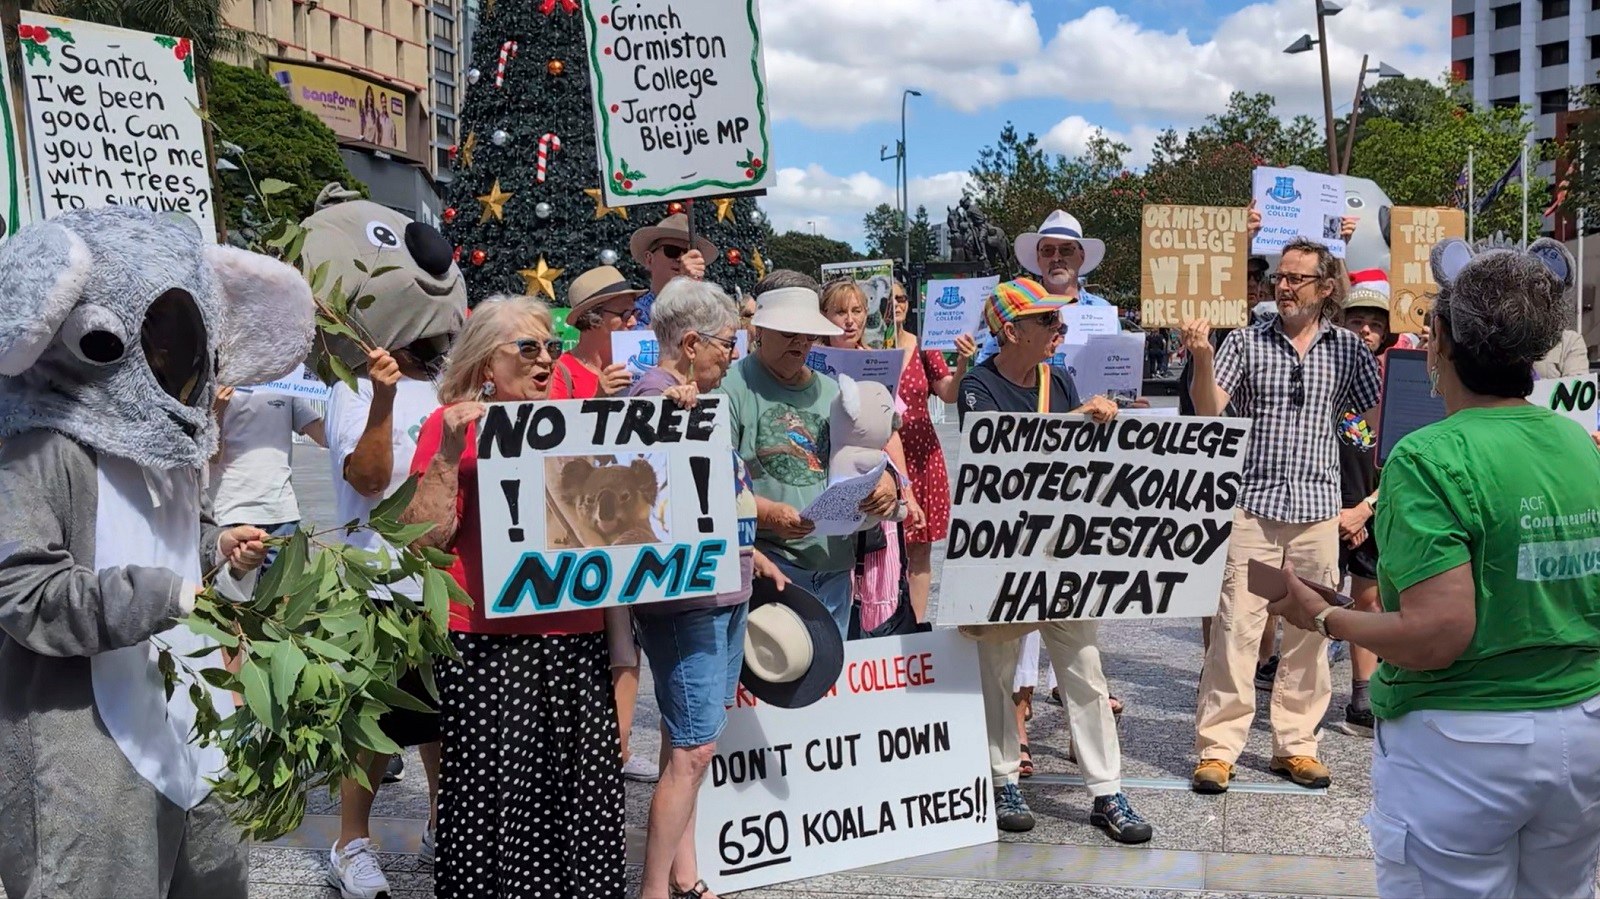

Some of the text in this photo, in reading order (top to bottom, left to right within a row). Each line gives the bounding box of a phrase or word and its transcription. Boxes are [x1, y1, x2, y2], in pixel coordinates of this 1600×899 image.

[611, 3, 681, 31] Grinch
[613, 31, 726, 61] Ormiston
[59, 44, 158, 85] Santa,
[32, 75, 164, 111] I've been
[634, 65, 717, 98] College
[42, 107, 179, 140] good. Can
[621, 98, 697, 124] Jarrod
[640, 117, 749, 155] Bleijie MP
[44, 137, 203, 174] you help me
[48, 162, 196, 195] with trees
[51, 188, 84, 210] to
[1265, 204, 1301, 213] ORMISTON
[1267, 210, 1297, 218] COLLEGE
[1145, 206, 1247, 232] ORMISTON
[1280, 227, 1299, 235] local
[1400, 224, 1446, 244] TREE
[1412, 209, 1439, 227] NO
[1149, 229, 1236, 253] COLLEGE
[1414, 244, 1430, 261] N
[1149, 254, 1233, 296] WTF
[1142, 299, 1179, 327] ARE
[1181, 299, 1195, 322] U
[293, 384, 327, 396] Vandals
[1551, 380, 1596, 412] NO
[478, 398, 720, 459] NO TREE
[970, 415, 1246, 458] ORMISTON COLLEGE
[953, 460, 1242, 512] PROTECT KOALAS
[1520, 495, 1545, 512] ACF
[947, 510, 1233, 565] DON'T DESTROY
[492, 540, 726, 613] NO ME
[988, 570, 1188, 623] HABITAT
[847, 653, 934, 694] COLLEGE
[712, 721, 950, 787] DON'T CUT DOWN
[718, 776, 987, 865] 650 KOALA TREES!!
